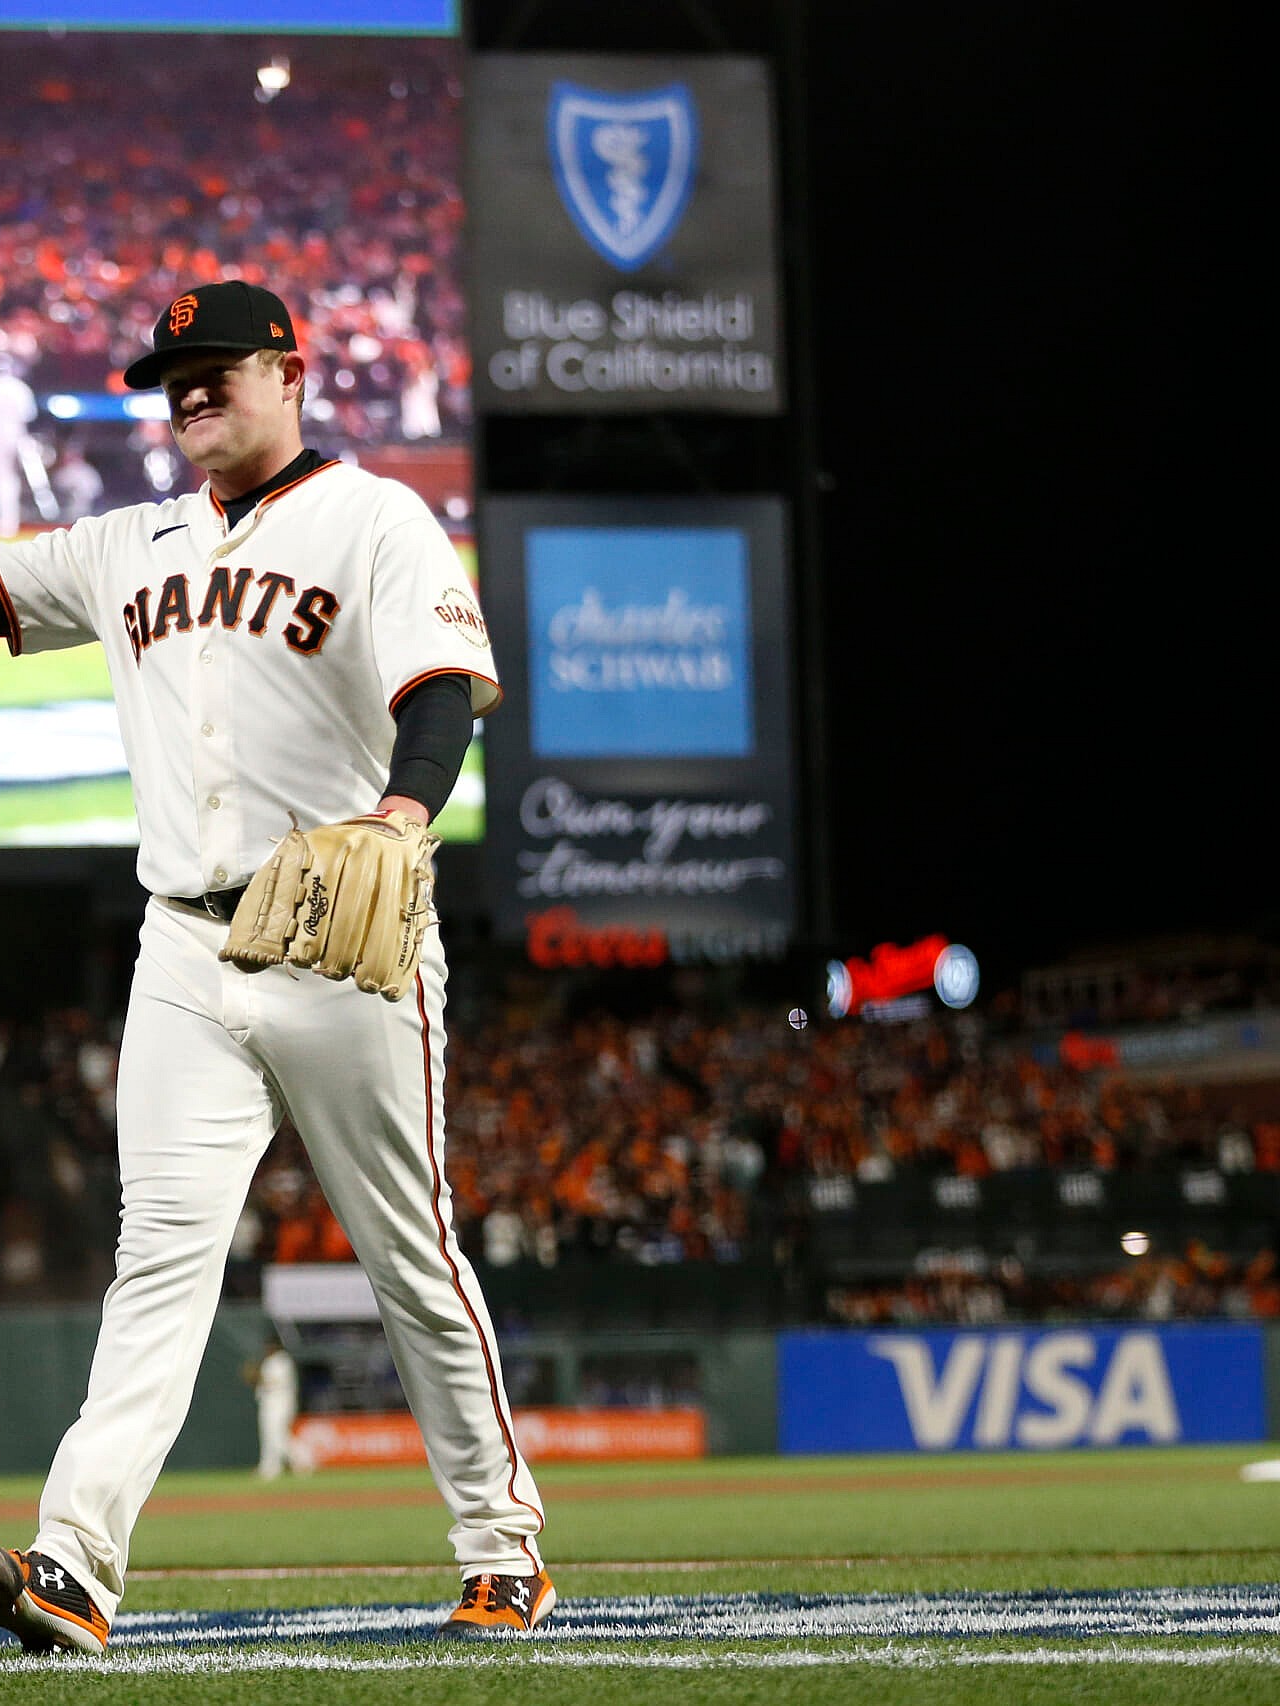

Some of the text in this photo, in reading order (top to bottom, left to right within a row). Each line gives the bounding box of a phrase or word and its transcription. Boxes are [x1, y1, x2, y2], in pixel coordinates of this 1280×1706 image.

[504, 290, 754, 341] Blue Shield
[488, 341, 773, 392] of California
[434, 604, 488, 634] GIANT
[551, 648, 731, 692] SCHWAB
[303, 874, 327, 937] Rawlings
[867, 1331, 1182, 1448] VISA
